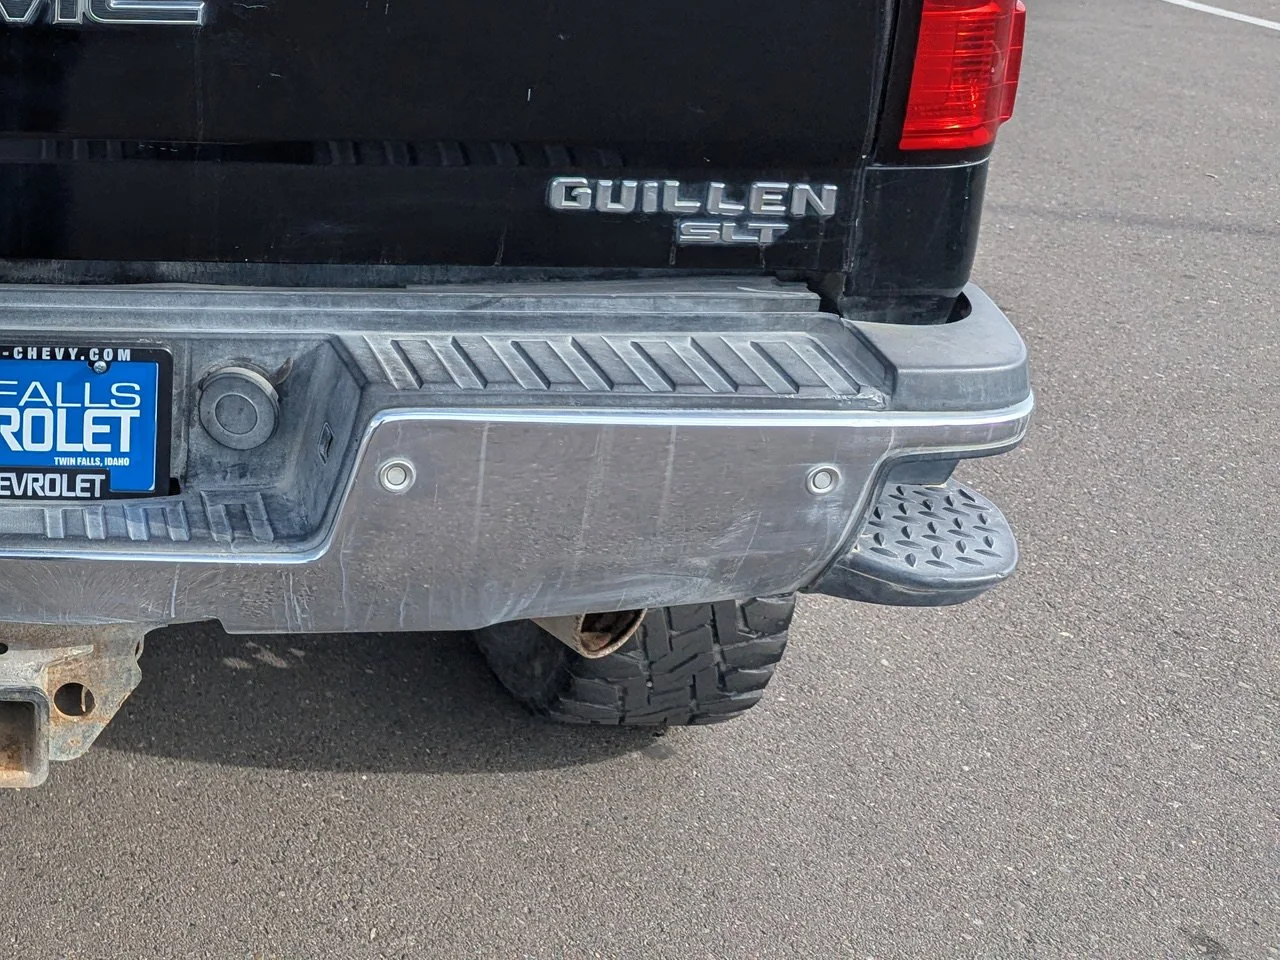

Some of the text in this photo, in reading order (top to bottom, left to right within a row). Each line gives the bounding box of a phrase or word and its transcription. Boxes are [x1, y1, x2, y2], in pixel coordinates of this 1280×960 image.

[549, 177, 838, 217] GUILLEN
[678, 222, 789, 243] SLT
[53, 456, 130, 468] TWIN FALLS, IDAHO
